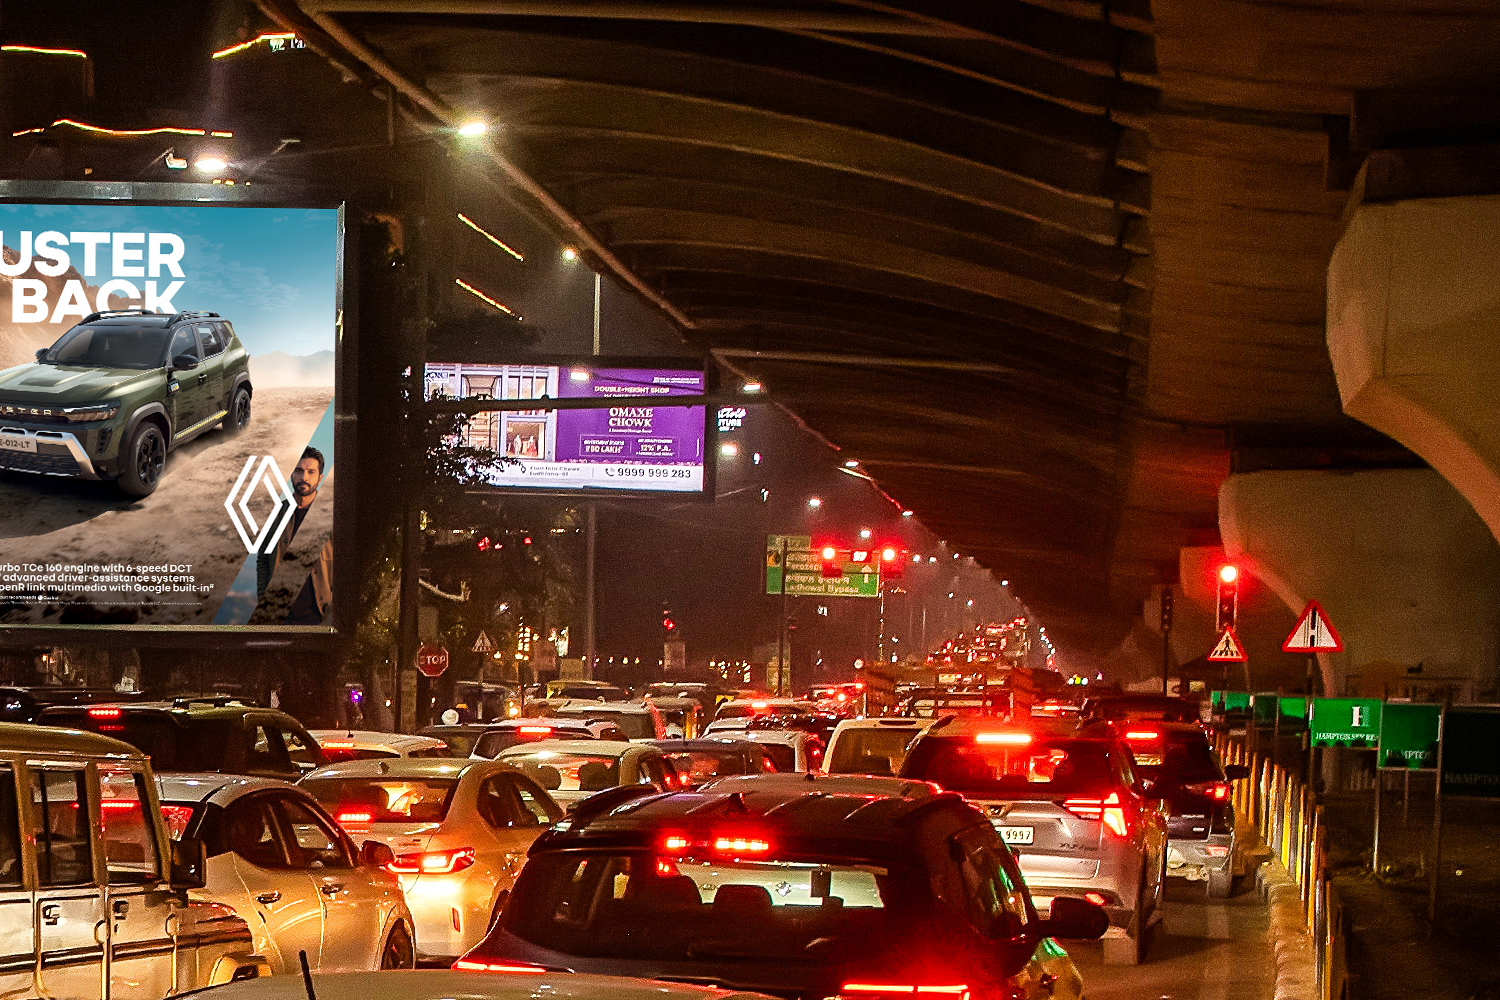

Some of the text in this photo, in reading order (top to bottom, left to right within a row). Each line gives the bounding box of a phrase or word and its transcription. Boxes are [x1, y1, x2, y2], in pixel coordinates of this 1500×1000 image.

[11, 279, 186, 324] BACK
[608, 407, 654, 418] OMAXE
[608, 417, 652, 427] CHOWK
[617, 467, 691, 478] 9999 999 283
[22, 564, 44, 573] TCe
[45, 564, 62, 573] 160
[63, 564, 100, 575] engine
[101, 563, 125, 573] with
[126, 564, 168, 575] 6-speed
[169, 564, 192, 573] DCT
[2, 573, 56, 582] advanced
[57, 573, 150, 583] driver-assistance
[151, 575, 195, 585] systems
[26, 583, 46, 593] link
[47, 583, 107, 593] multimedia
[108, 583, 132, 593] with
[133, 583, 173, 594] Google
[419, 655, 446, 665] STOP
[1005, 829, 1031, 840] 9997
